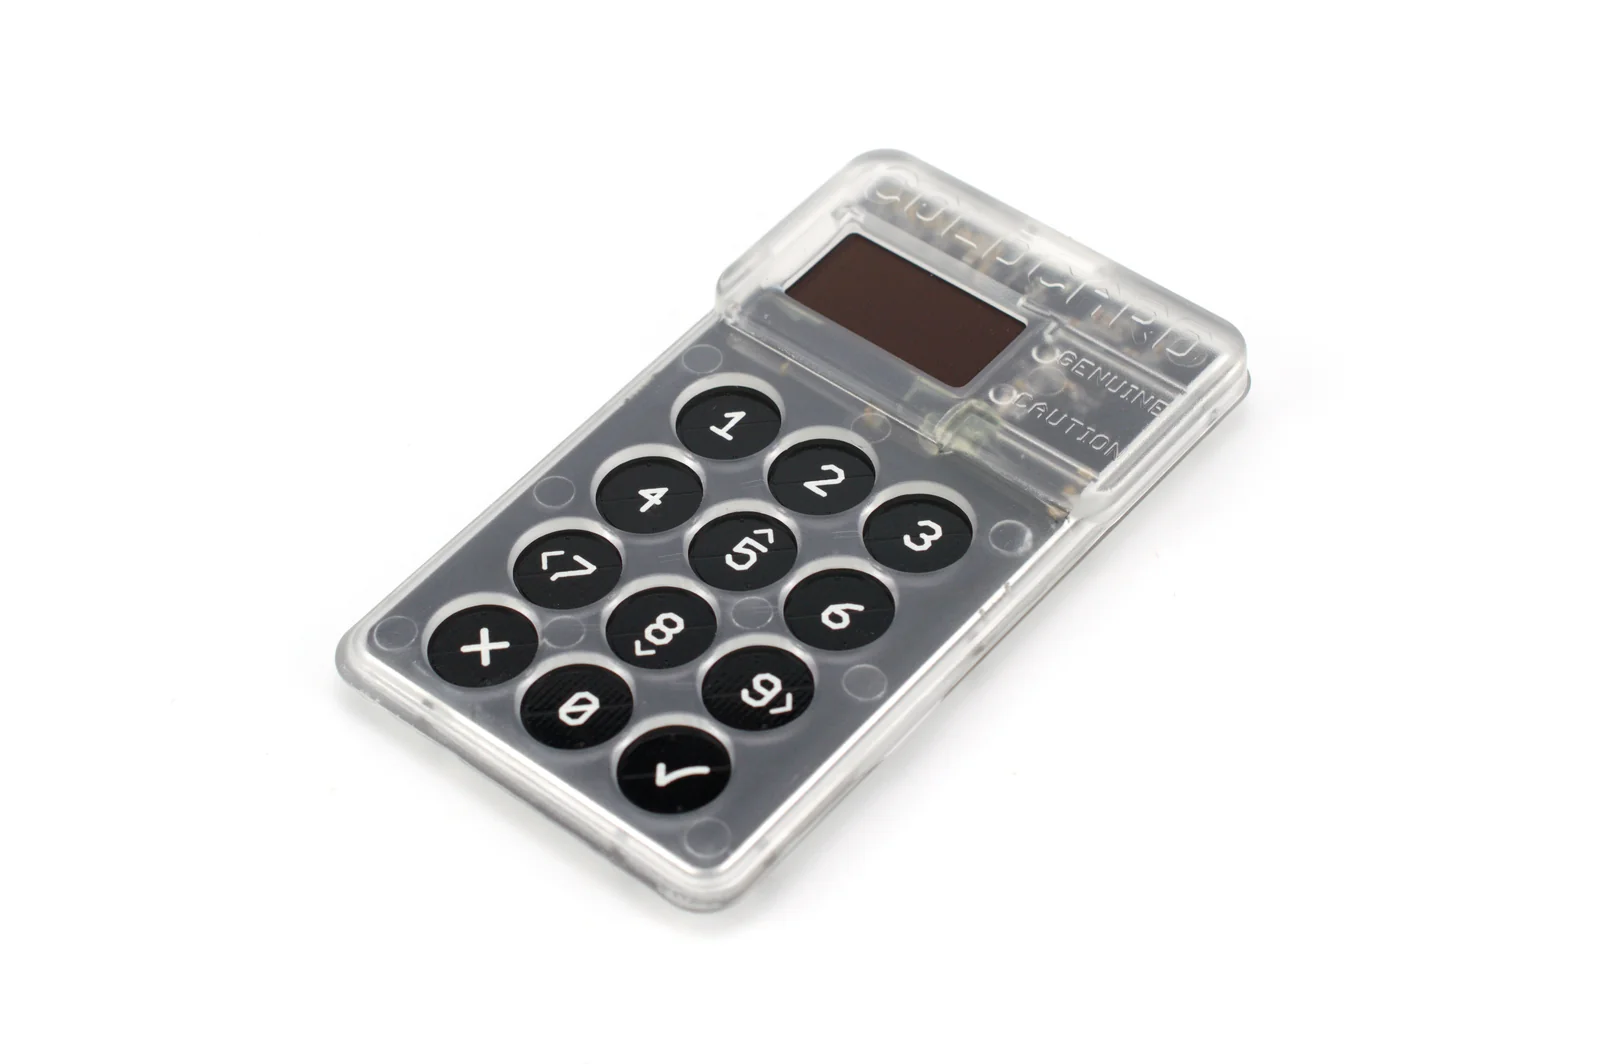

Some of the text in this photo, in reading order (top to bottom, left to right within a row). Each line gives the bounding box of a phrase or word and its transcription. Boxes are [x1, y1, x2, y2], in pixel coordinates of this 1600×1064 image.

[1057, 350, 1169, 417] GENUINE
[709, 410, 747, 441] 1
[1011, 391, 1123, 459] CAUTION
[803, 463, 846, 498] 2
[637, 487, 669, 513] 4
[903, 519, 943, 552] 3
[549, 554, 597, 582] 7
[724, 536, 769, 571] 5
[644, 612, 685, 646] 8
[820, 602, 865, 630] 6
[740, 672, 783, 708] 9
[558, 691, 600, 726] 0
